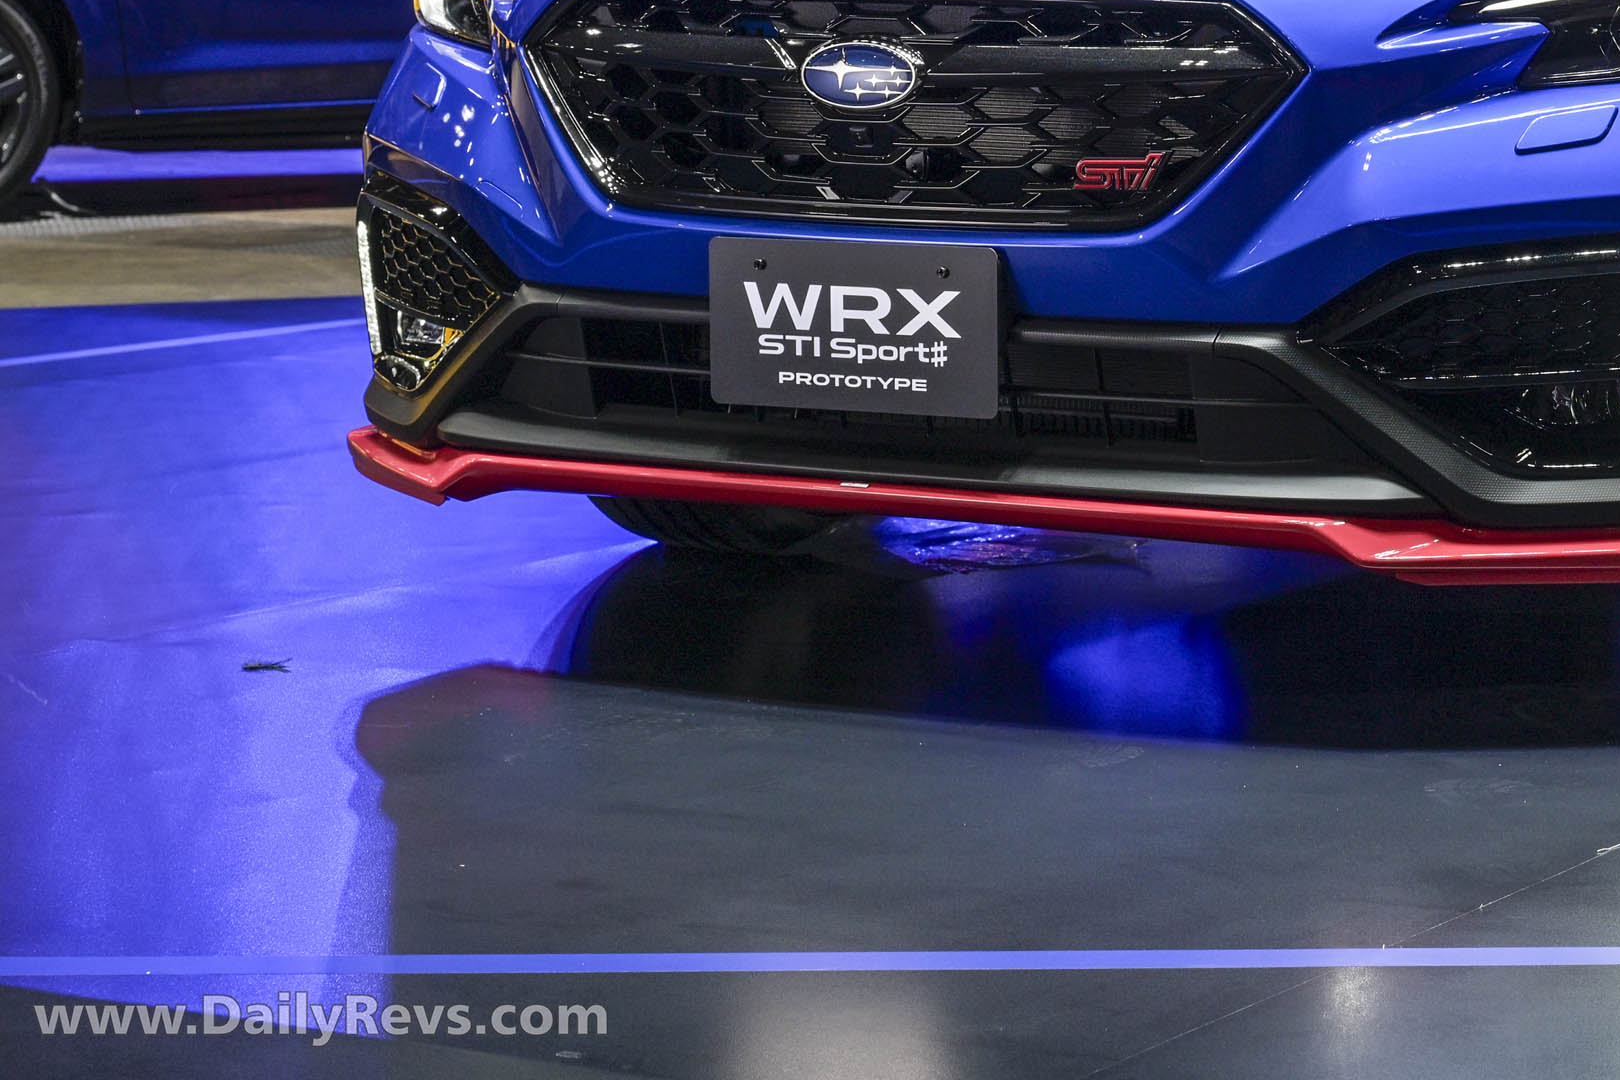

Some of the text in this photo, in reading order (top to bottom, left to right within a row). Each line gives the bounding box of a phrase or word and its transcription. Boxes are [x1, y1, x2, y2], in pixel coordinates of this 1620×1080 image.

[743, 281, 962, 339] WRX
[758, 334, 821, 358] STI
[778, 370, 928, 393] PROTOTYPE
